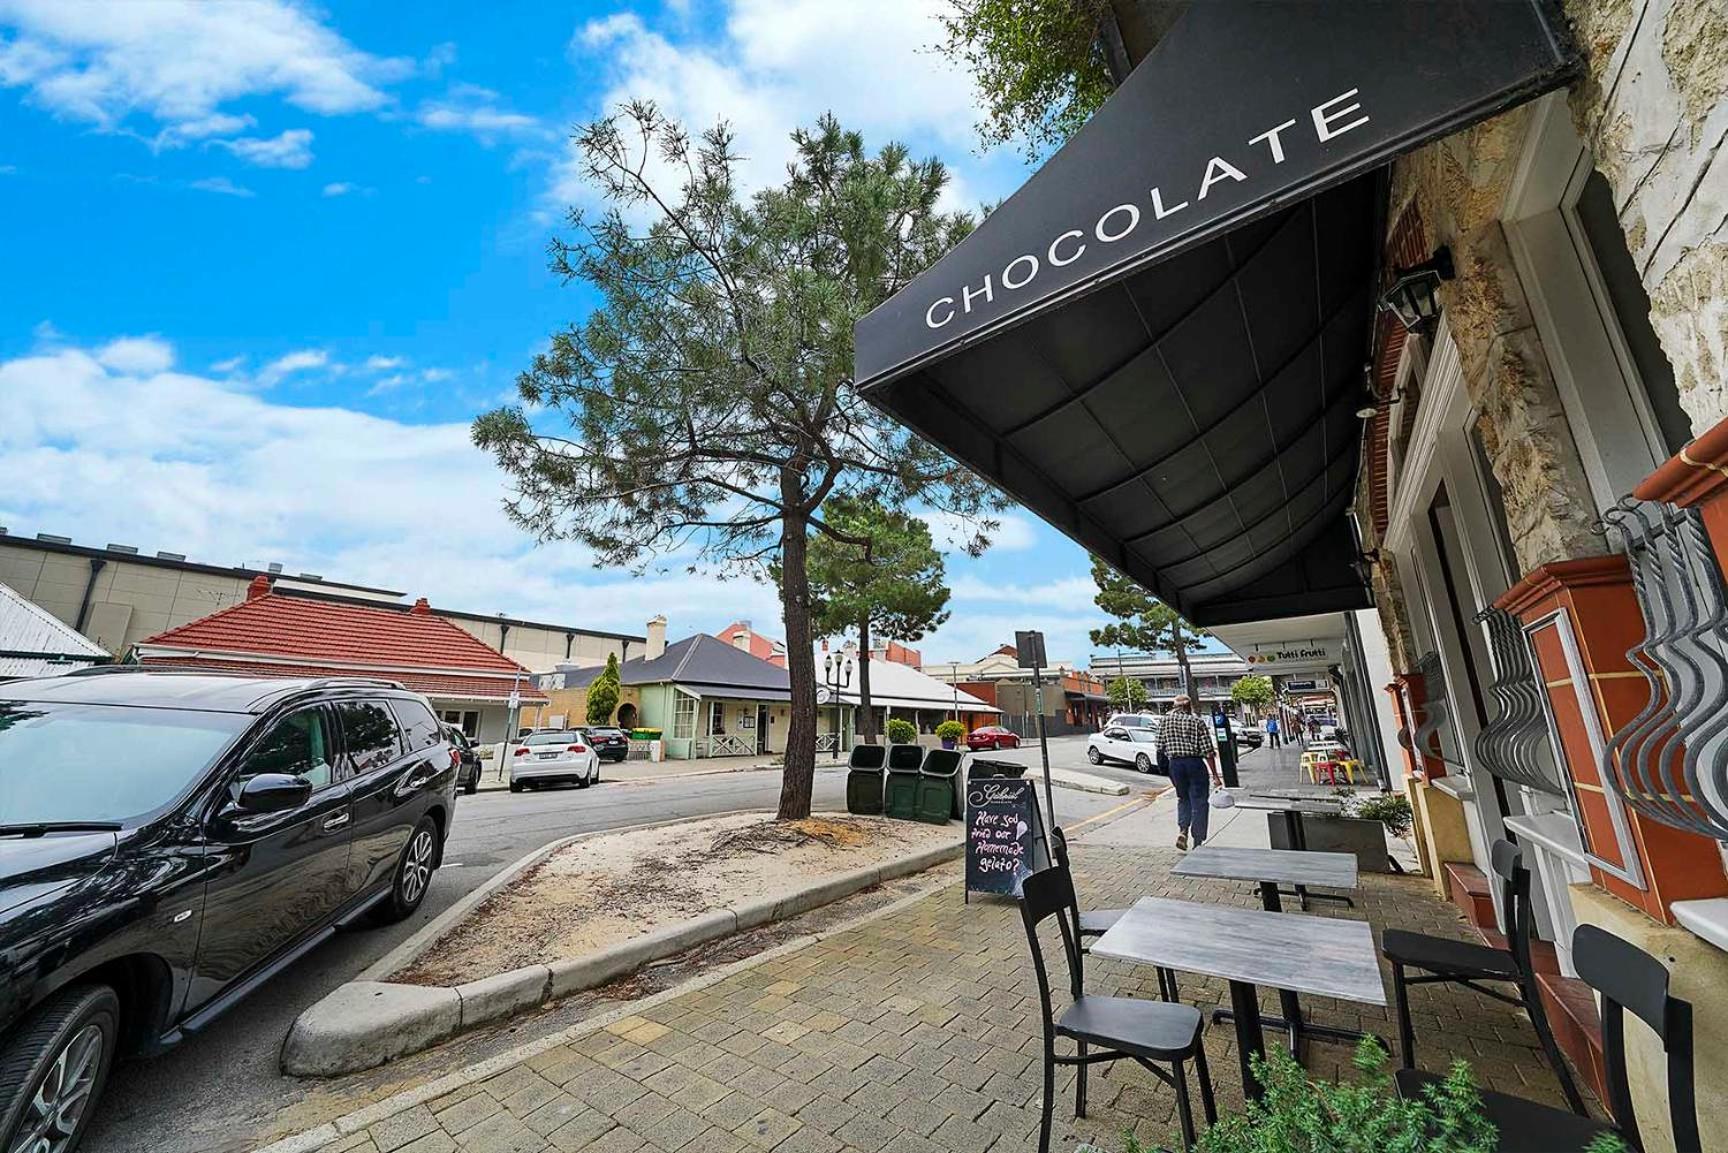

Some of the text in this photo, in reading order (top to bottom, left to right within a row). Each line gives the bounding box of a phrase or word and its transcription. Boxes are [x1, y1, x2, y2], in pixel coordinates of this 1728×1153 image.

[926, 87, 1370, 329] CHOCOLATE
[1277, 650, 1298, 659] Tutti
[976, 811, 1018, 827] Have you
